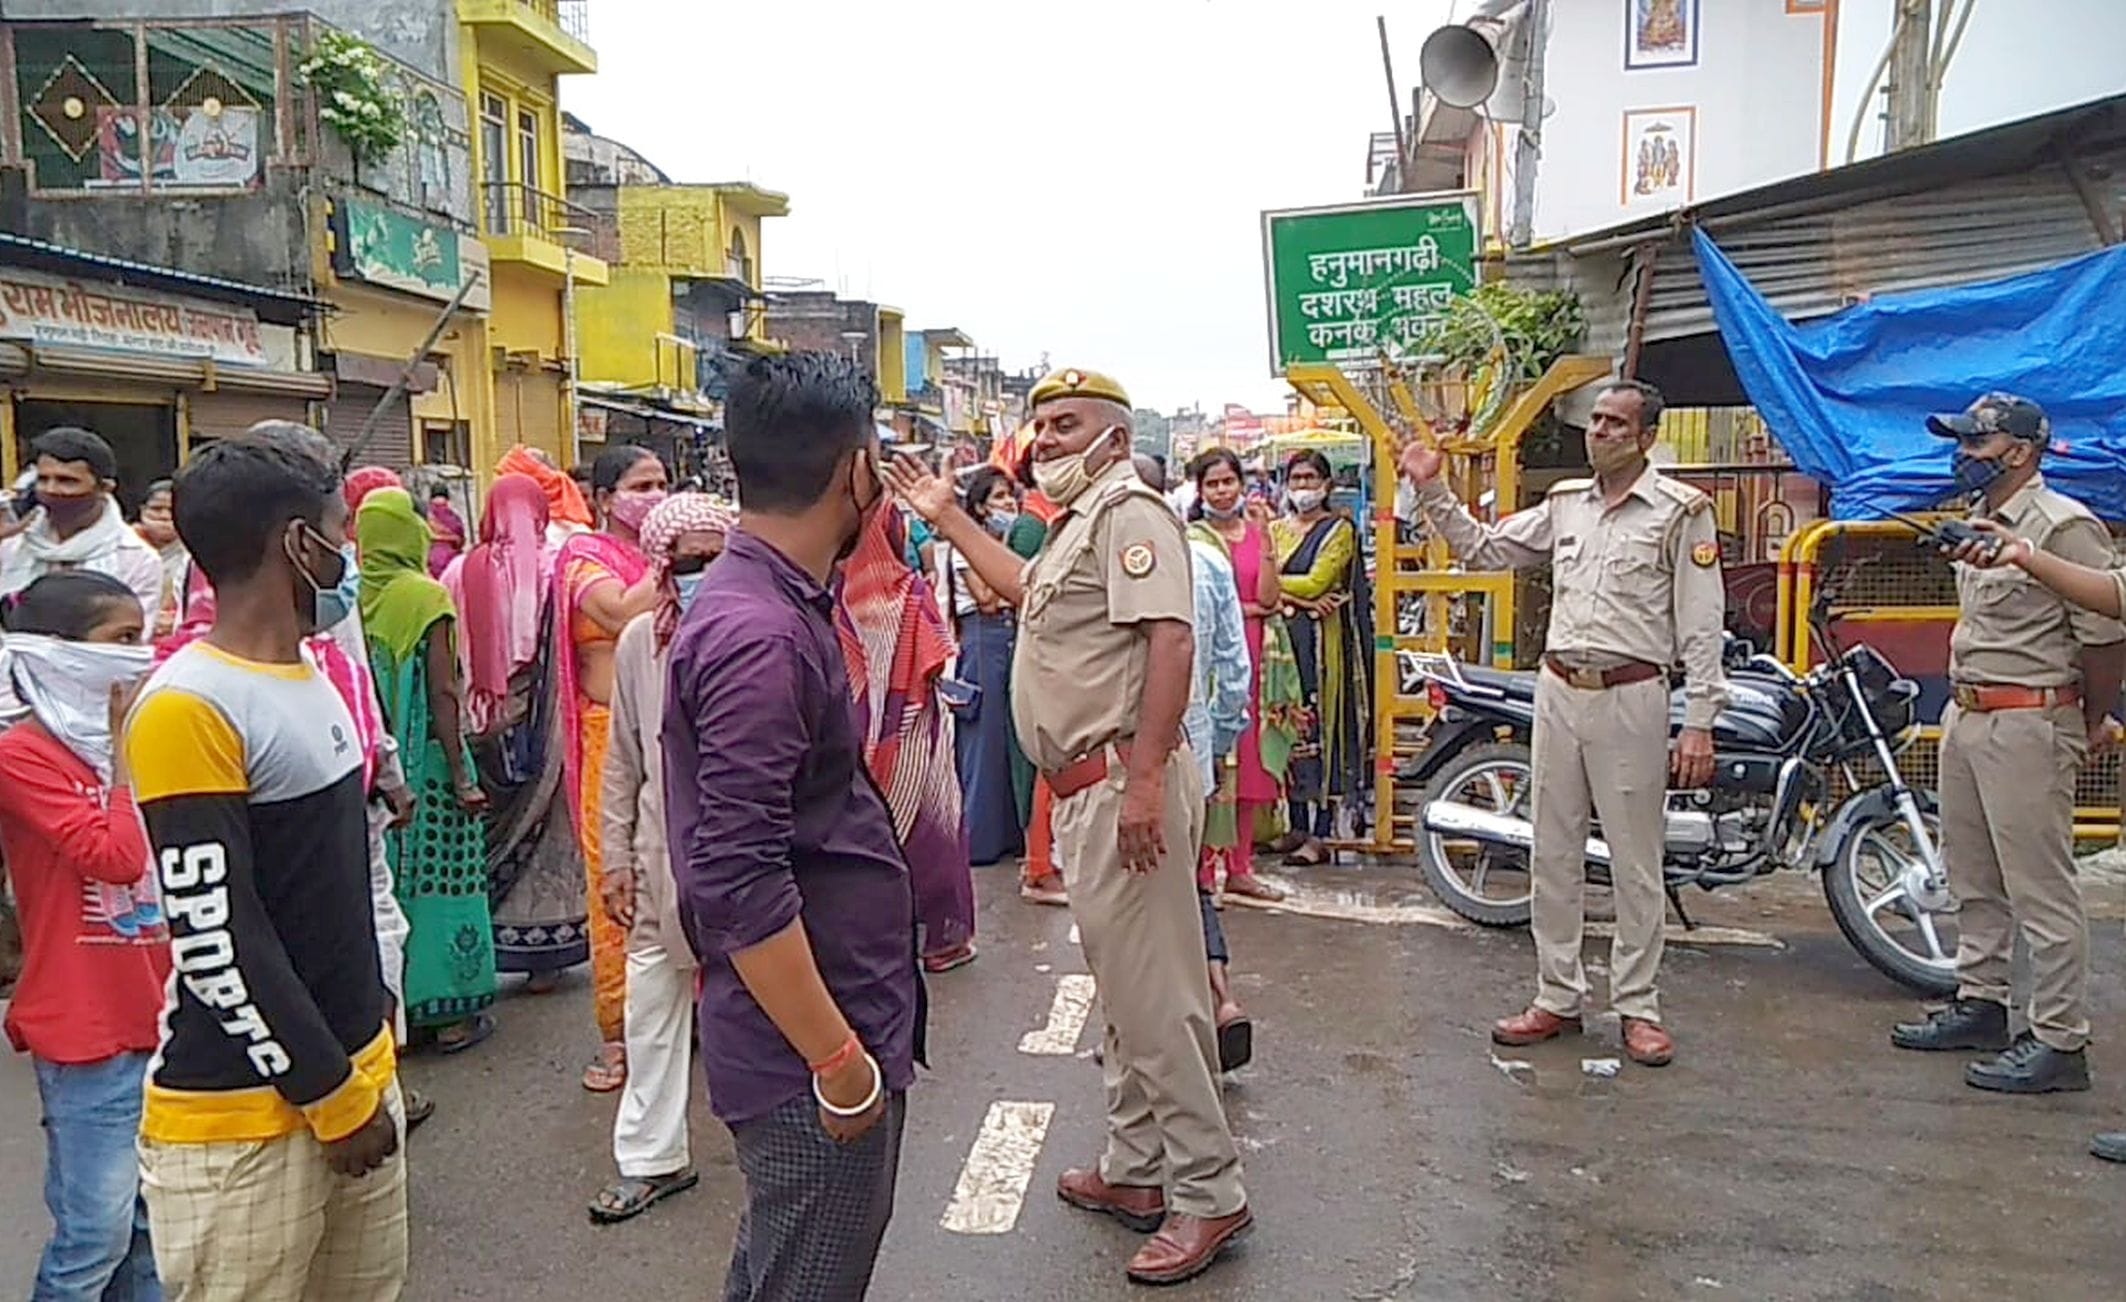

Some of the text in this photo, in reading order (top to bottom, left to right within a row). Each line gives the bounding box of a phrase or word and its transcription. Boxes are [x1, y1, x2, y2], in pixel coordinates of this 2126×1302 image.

[1308, 234, 1439, 288] हनुमानगढ़ी
[1, 280, 58, 319] राम
[1298, 282, 1453, 319] दशरथ महल
[1306, 319, 1378, 348] कनक
